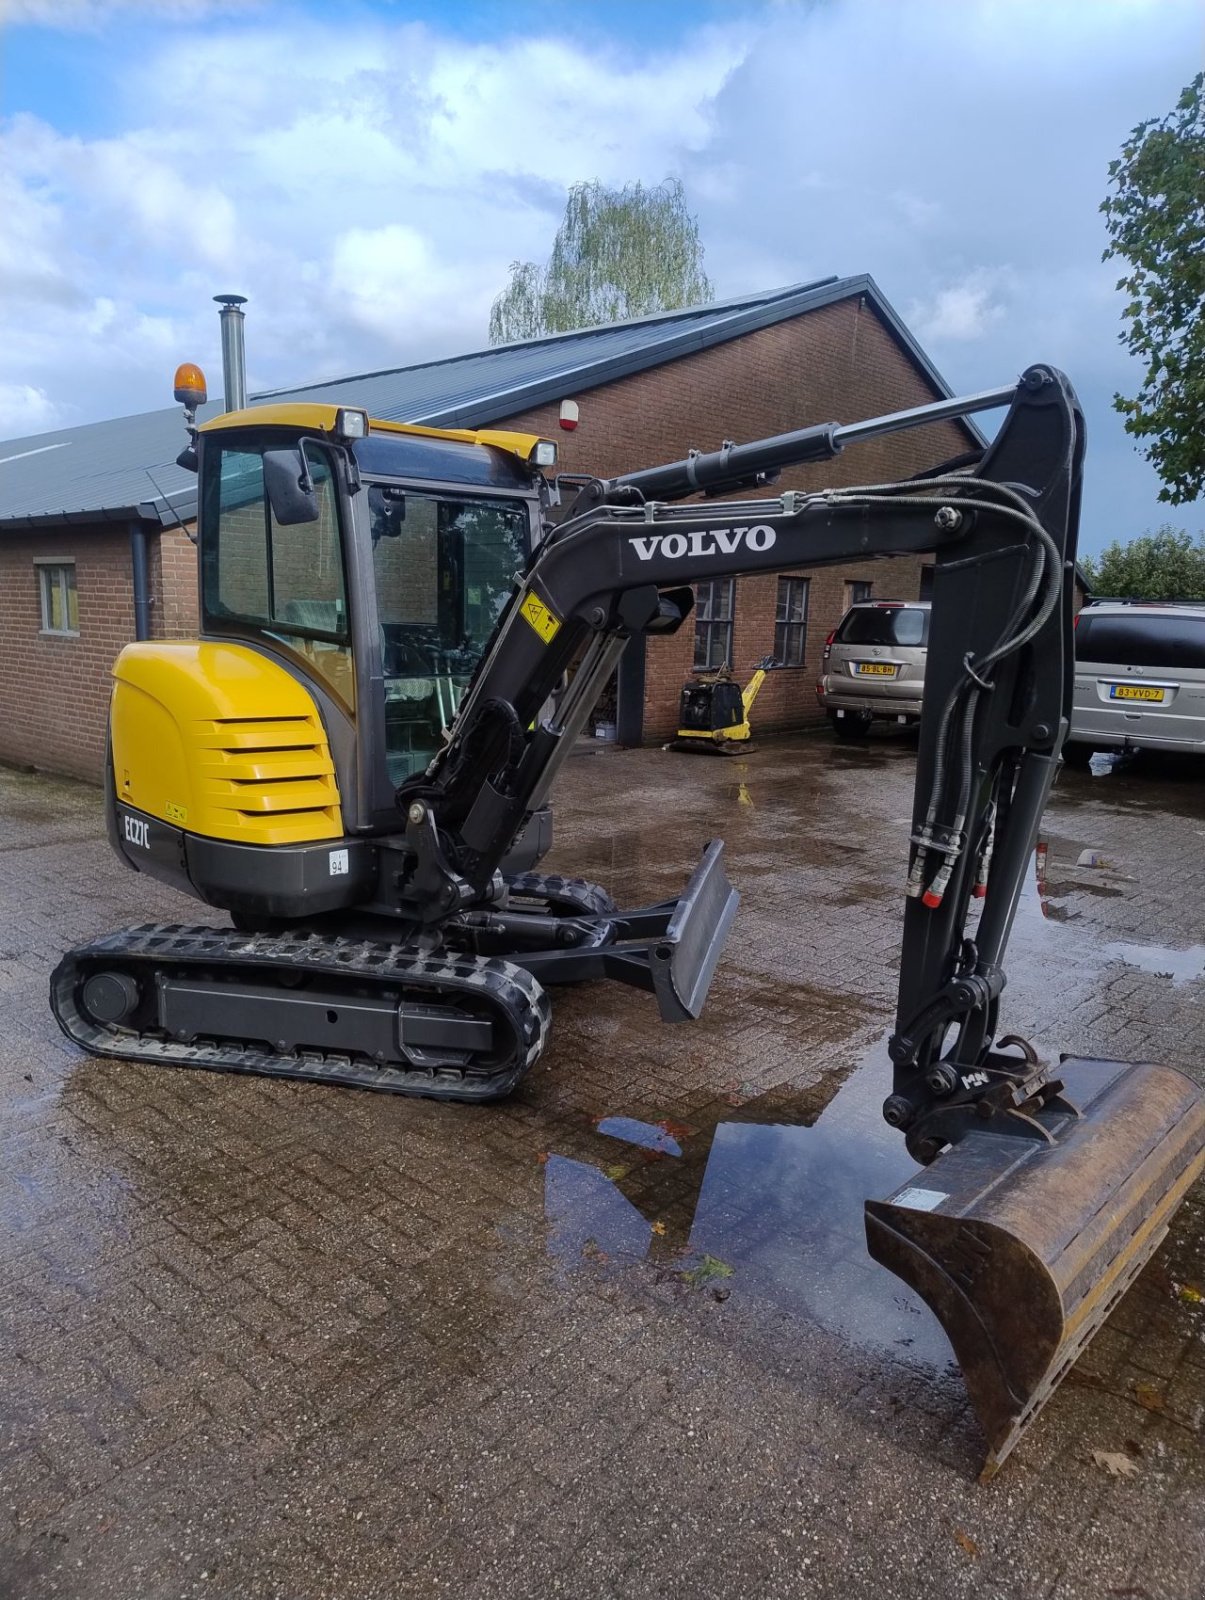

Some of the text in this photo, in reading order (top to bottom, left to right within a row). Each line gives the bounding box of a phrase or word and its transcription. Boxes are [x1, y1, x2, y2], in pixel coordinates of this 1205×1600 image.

[628, 525, 777, 561] VOLVO
[1118, 688, 1160, 698] 83-VVD-7
[124, 815, 151, 850] EC27C
[331, 860, 342, 874] 94
